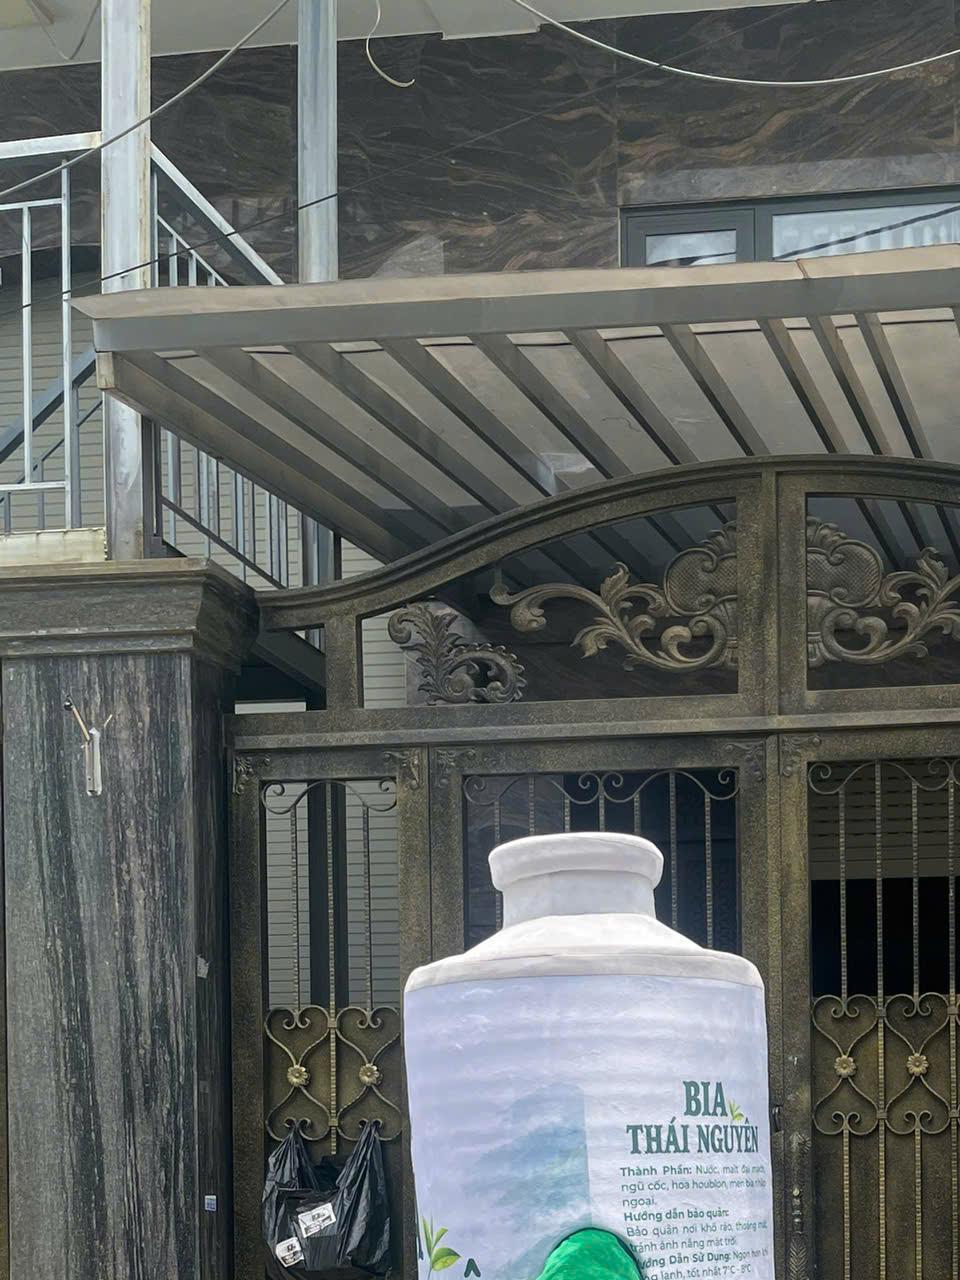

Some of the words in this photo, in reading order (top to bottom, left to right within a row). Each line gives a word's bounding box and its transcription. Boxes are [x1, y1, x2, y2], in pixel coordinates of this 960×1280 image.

[682, 1080, 728, 1117] BIA
[626, 1116, 690, 1154] THÁI
[696, 1117, 759, 1153] NGUYÊN
[620, 1165, 657, 1177] Thành
[663, 1164, 692, 1176] Phần:
